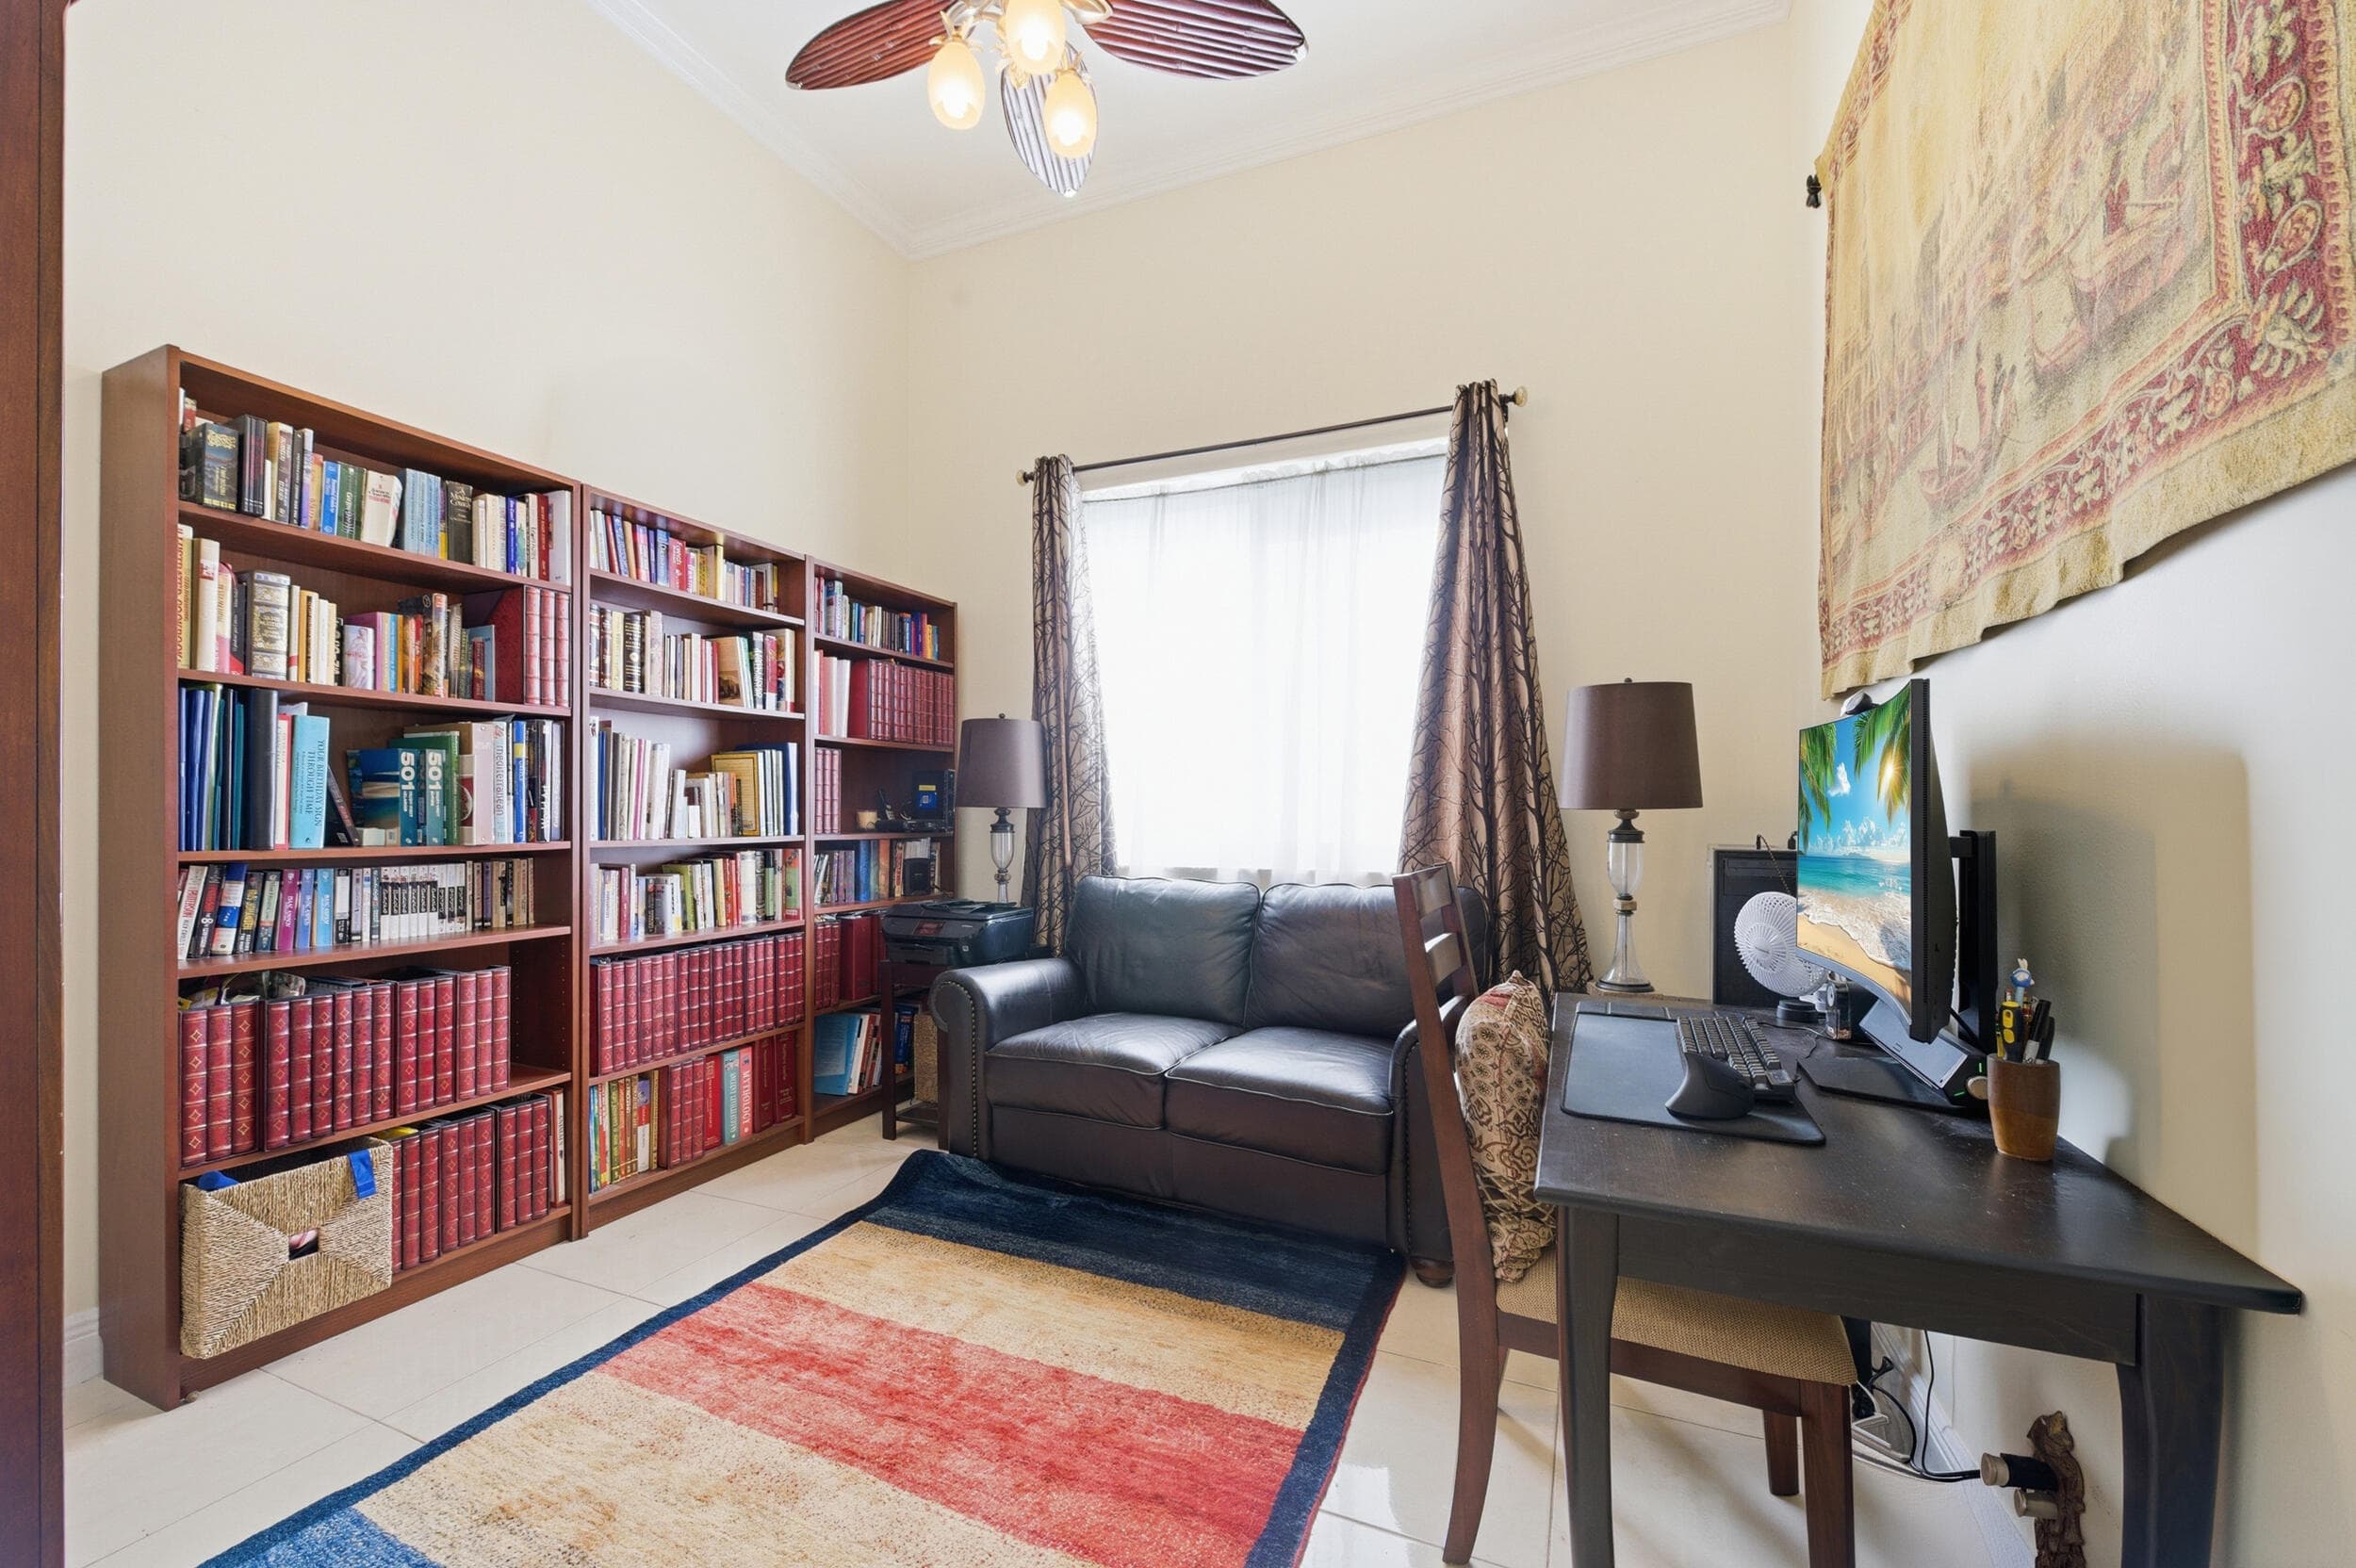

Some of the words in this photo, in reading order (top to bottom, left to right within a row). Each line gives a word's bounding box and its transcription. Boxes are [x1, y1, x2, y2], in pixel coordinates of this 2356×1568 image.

[305, 750, 316, 793] THROUGH
[317, 740, 325, 763] YOUR
[401, 751, 415, 791] 501
[428, 752, 442, 790] 501
[315, 764, 324, 806] BIRTHDAY
[495, 745, 505, 816] mediterranean
[305, 795, 315, 814] TIME
[314, 807, 323, 826] SIGN
[742, 1070, 751, 1123] MYTHOLOGY
